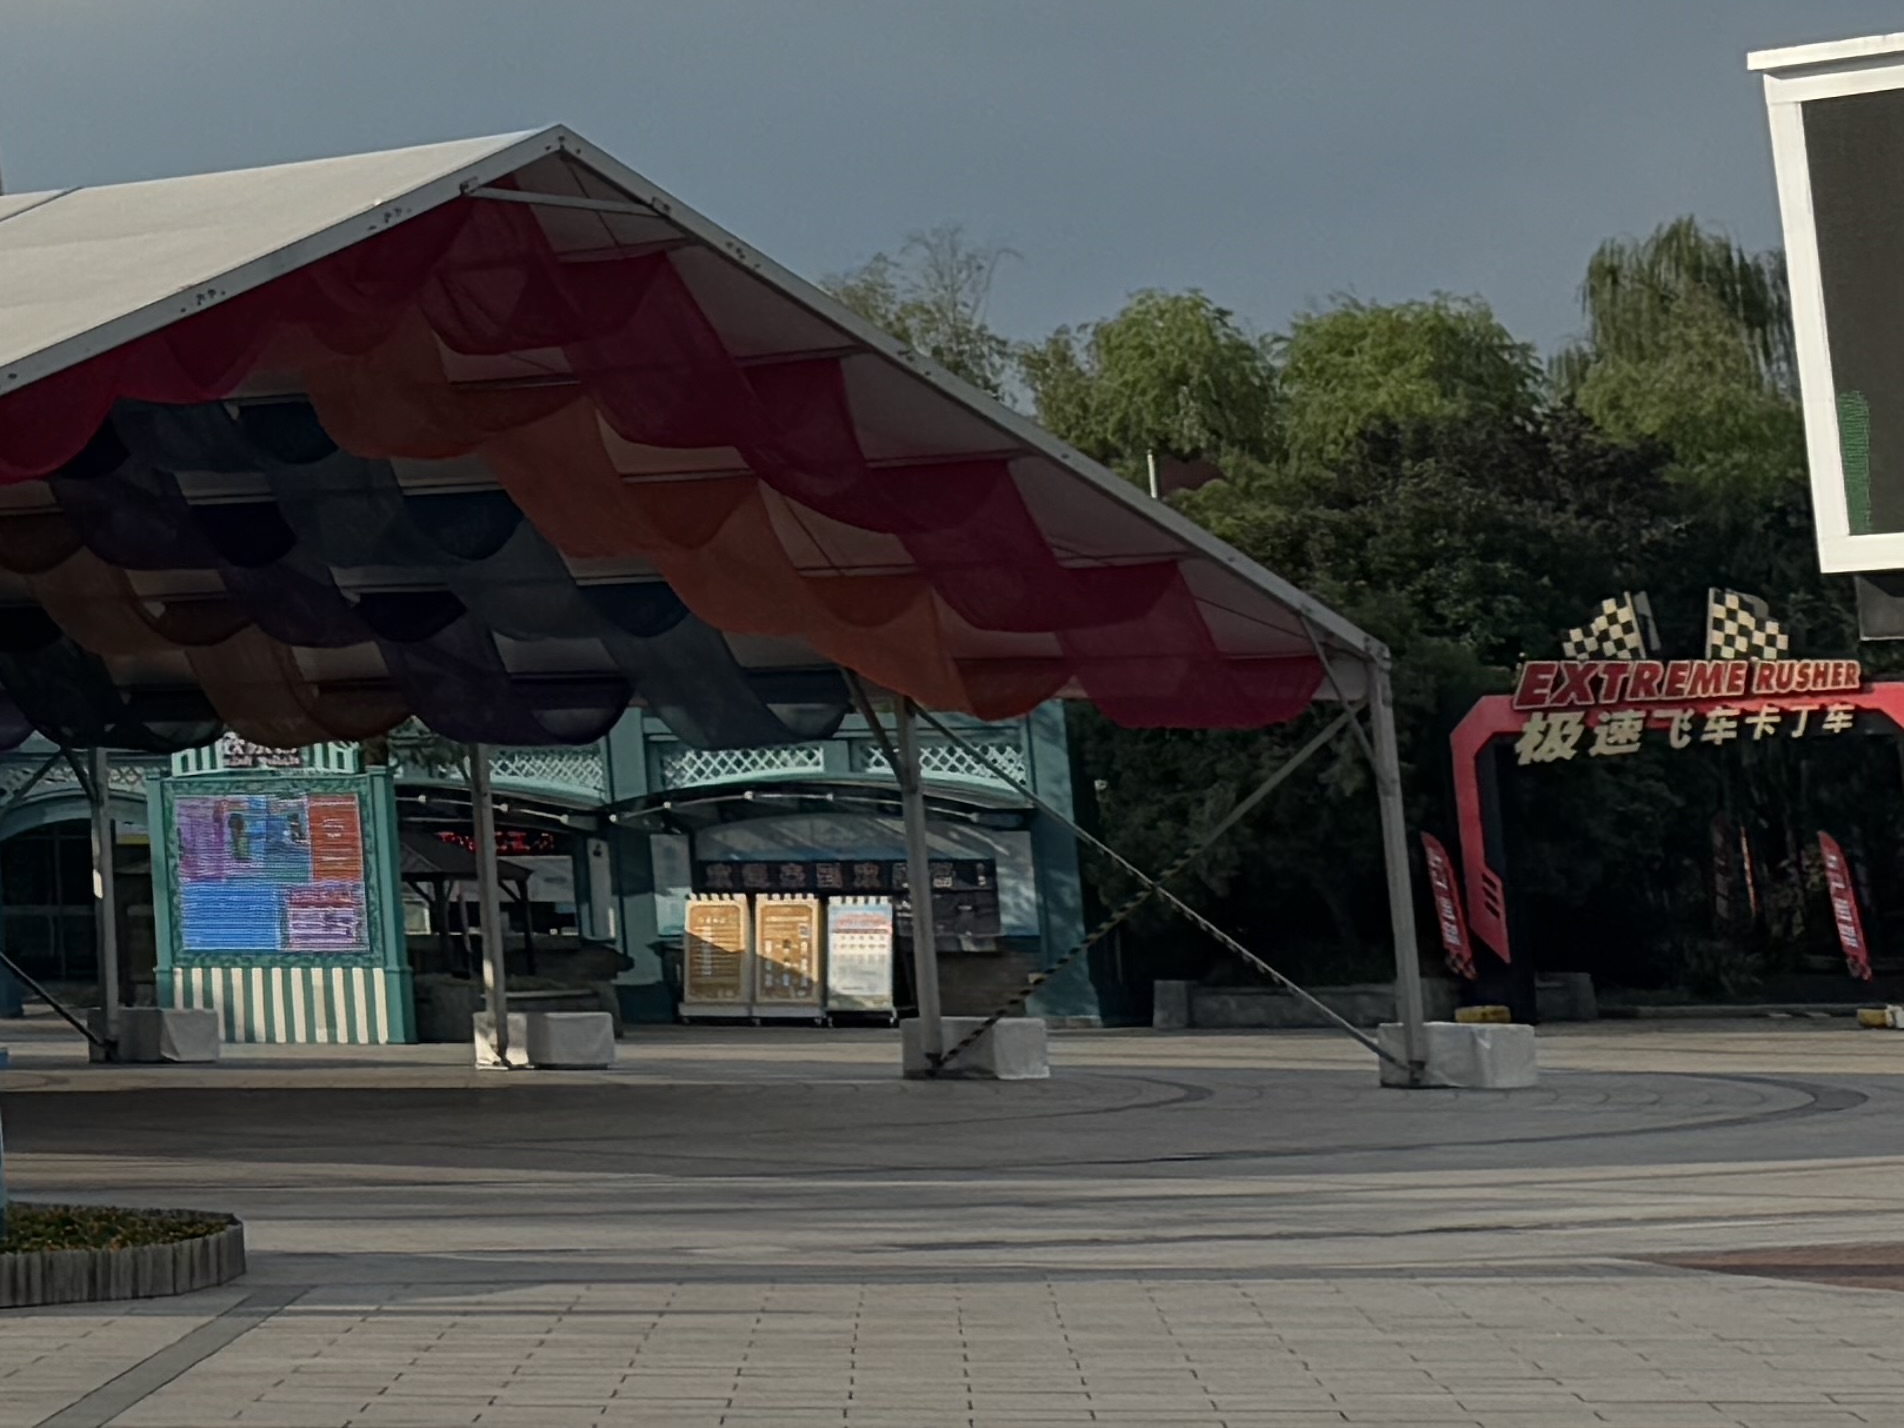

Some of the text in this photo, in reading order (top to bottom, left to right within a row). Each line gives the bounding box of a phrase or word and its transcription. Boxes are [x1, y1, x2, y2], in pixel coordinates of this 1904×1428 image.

[1514, 659, 1861, 709] EXTREME RUSHER
[1514, 705, 1855, 764] 极速飞车卡丁车
